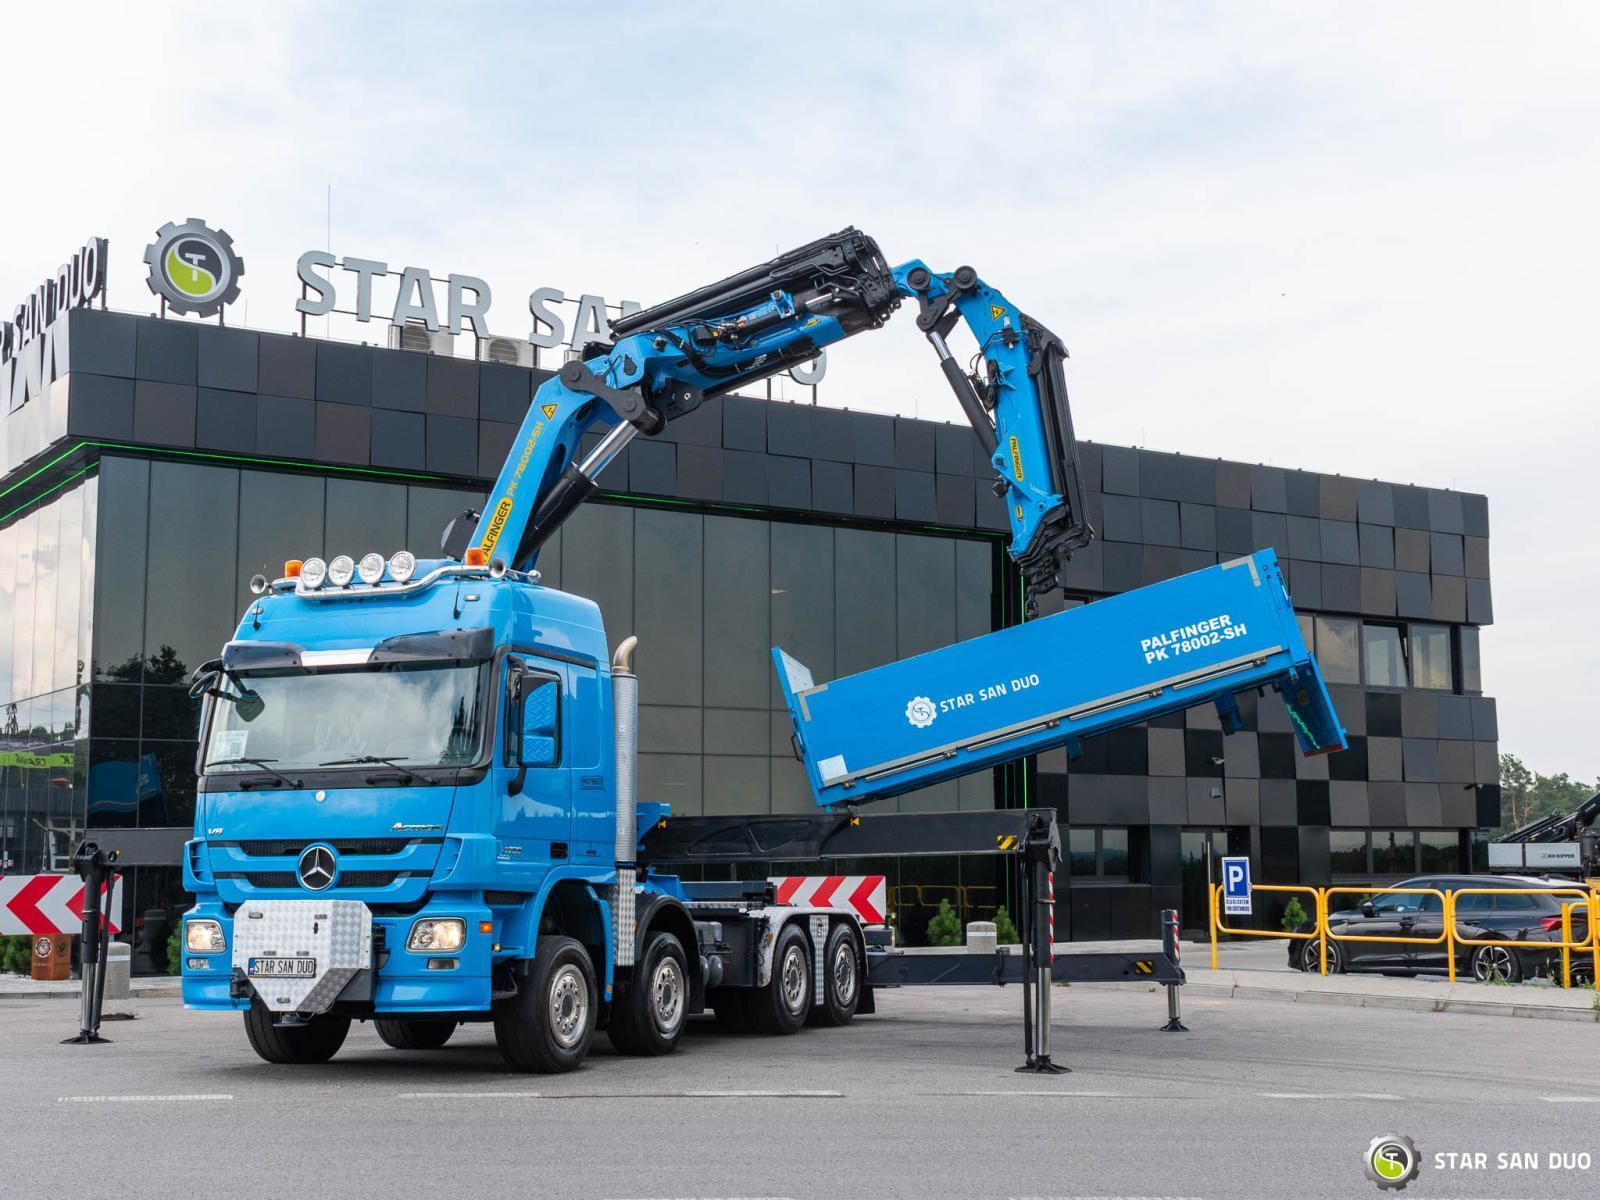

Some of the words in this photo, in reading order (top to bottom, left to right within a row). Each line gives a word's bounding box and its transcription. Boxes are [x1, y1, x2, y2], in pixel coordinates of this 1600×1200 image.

[12, 279, 52, 358] SAN
[56, 236, 102, 319] DUO
[295, 250, 492, 339] STAR
[528, 287, 641, 349] SA
[482, 501, 512, 562] ALFINGER
[506, 480, 519, 497] PK
[514, 422, 544, 480] 78002-SH
[1140, 614, 1232, 652] PALFINGER
[1145, 647, 1169, 665] PK
[1171, 623, 1248, 656] 78002-SH
[940, 693, 975, 713] STAR
[978, 683, 1007, 701] SAN
[1011, 673, 1040, 692] DUO
[1228, 865, 1244, 892] P
[255, 960, 275, 974] STAR
[277, 960, 294, 974] SAN
[296, 960, 314, 974] DUO
